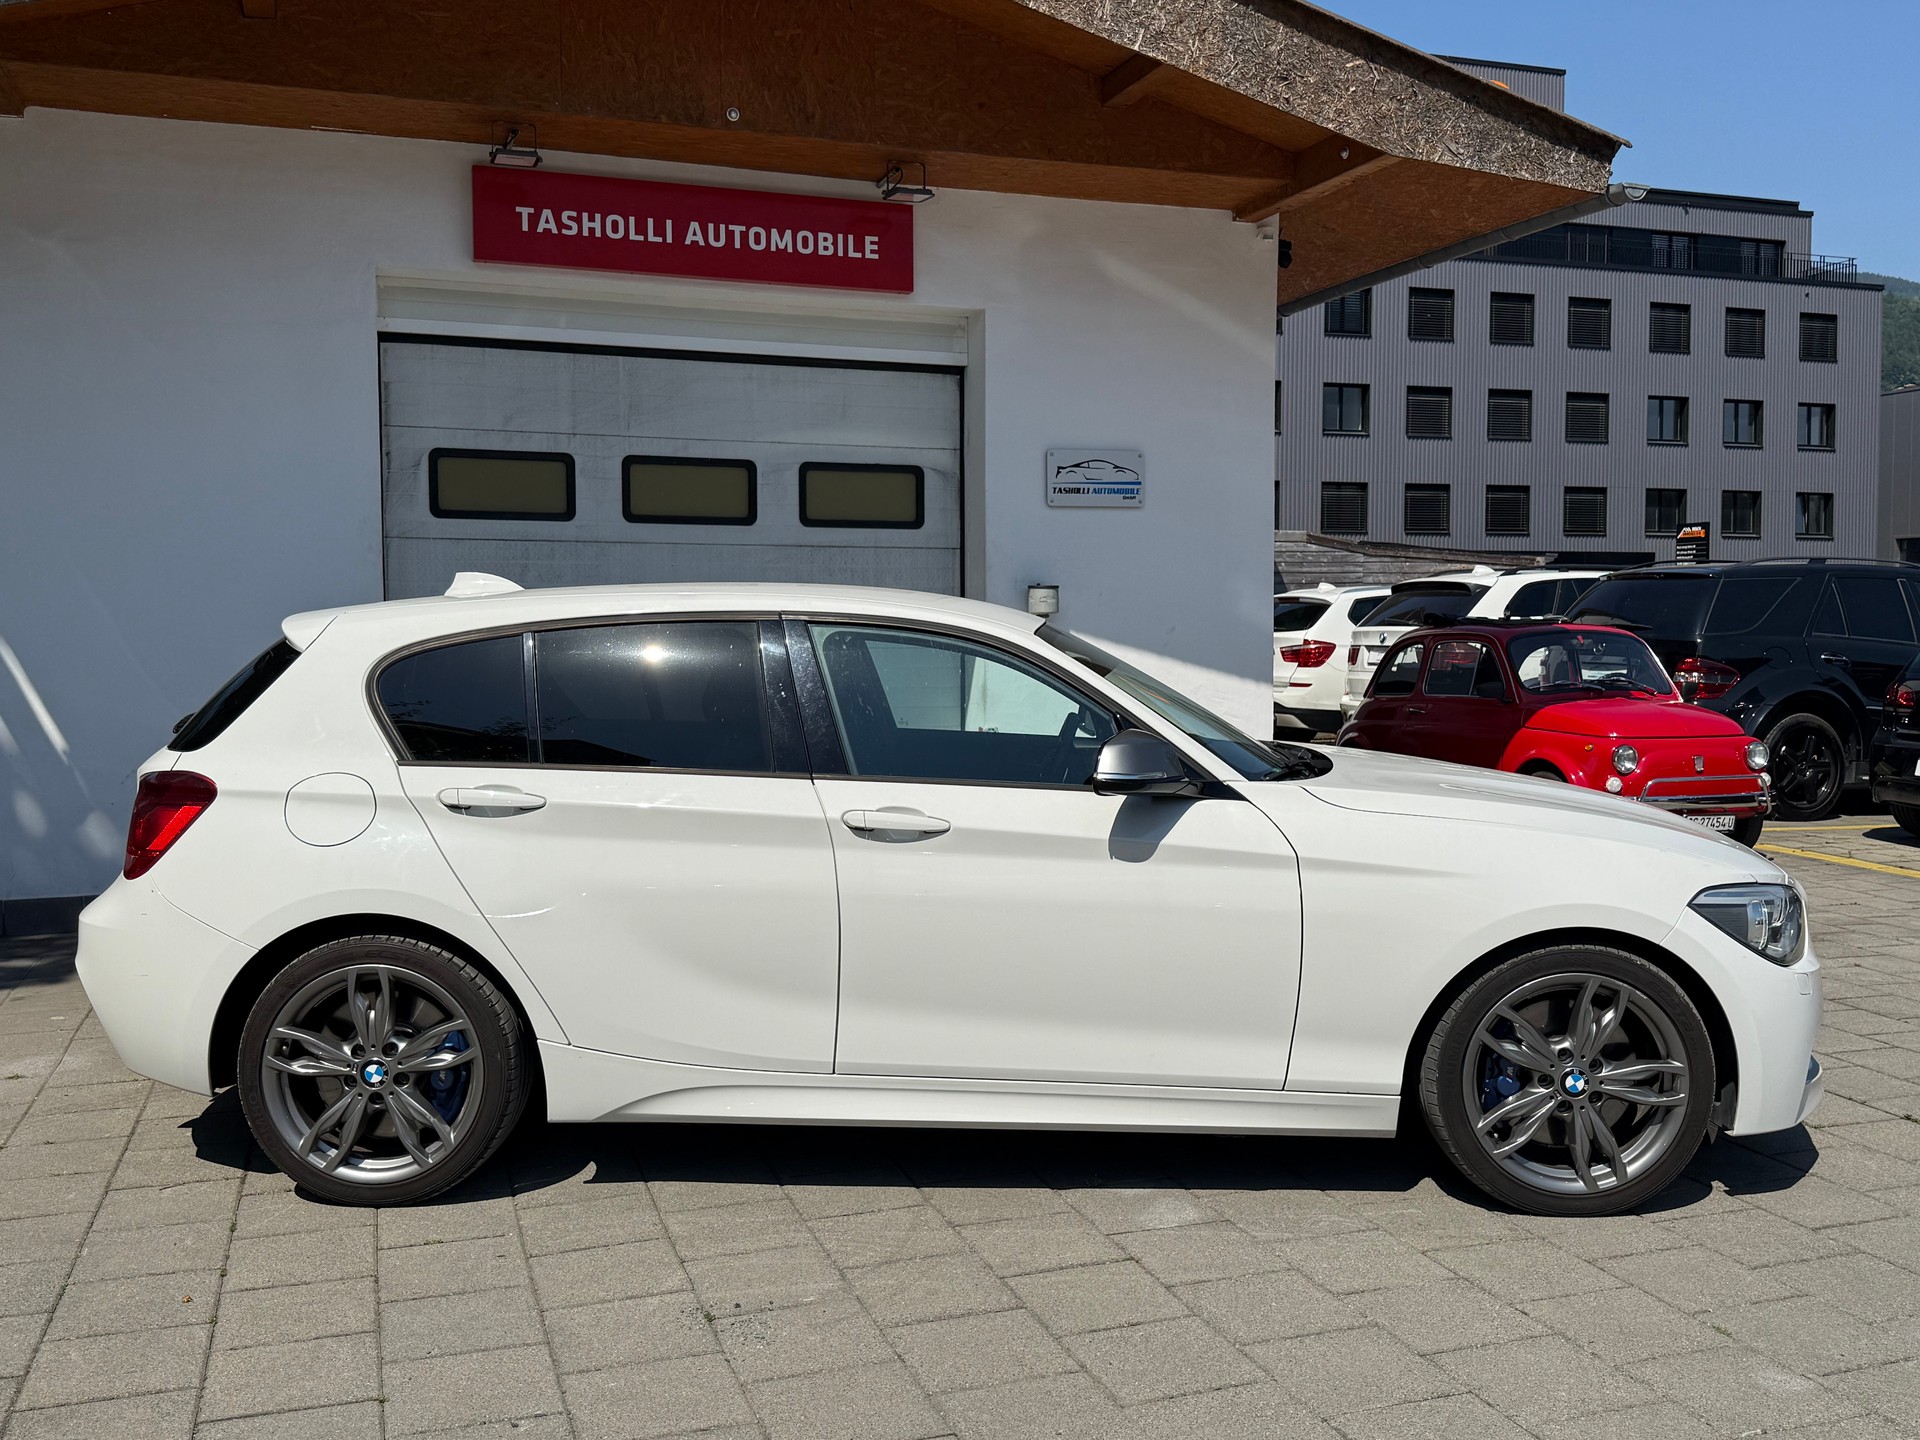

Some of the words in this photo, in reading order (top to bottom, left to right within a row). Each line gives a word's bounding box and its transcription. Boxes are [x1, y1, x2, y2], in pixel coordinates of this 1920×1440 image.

[515, 205, 674, 244] TASHOLLI
[684, 220, 880, 260] AUTOMOBILE
[1052, 486, 1090, 495] TASHOLLI
[1091, 487, 1141, 496] AUTOMOBILE
